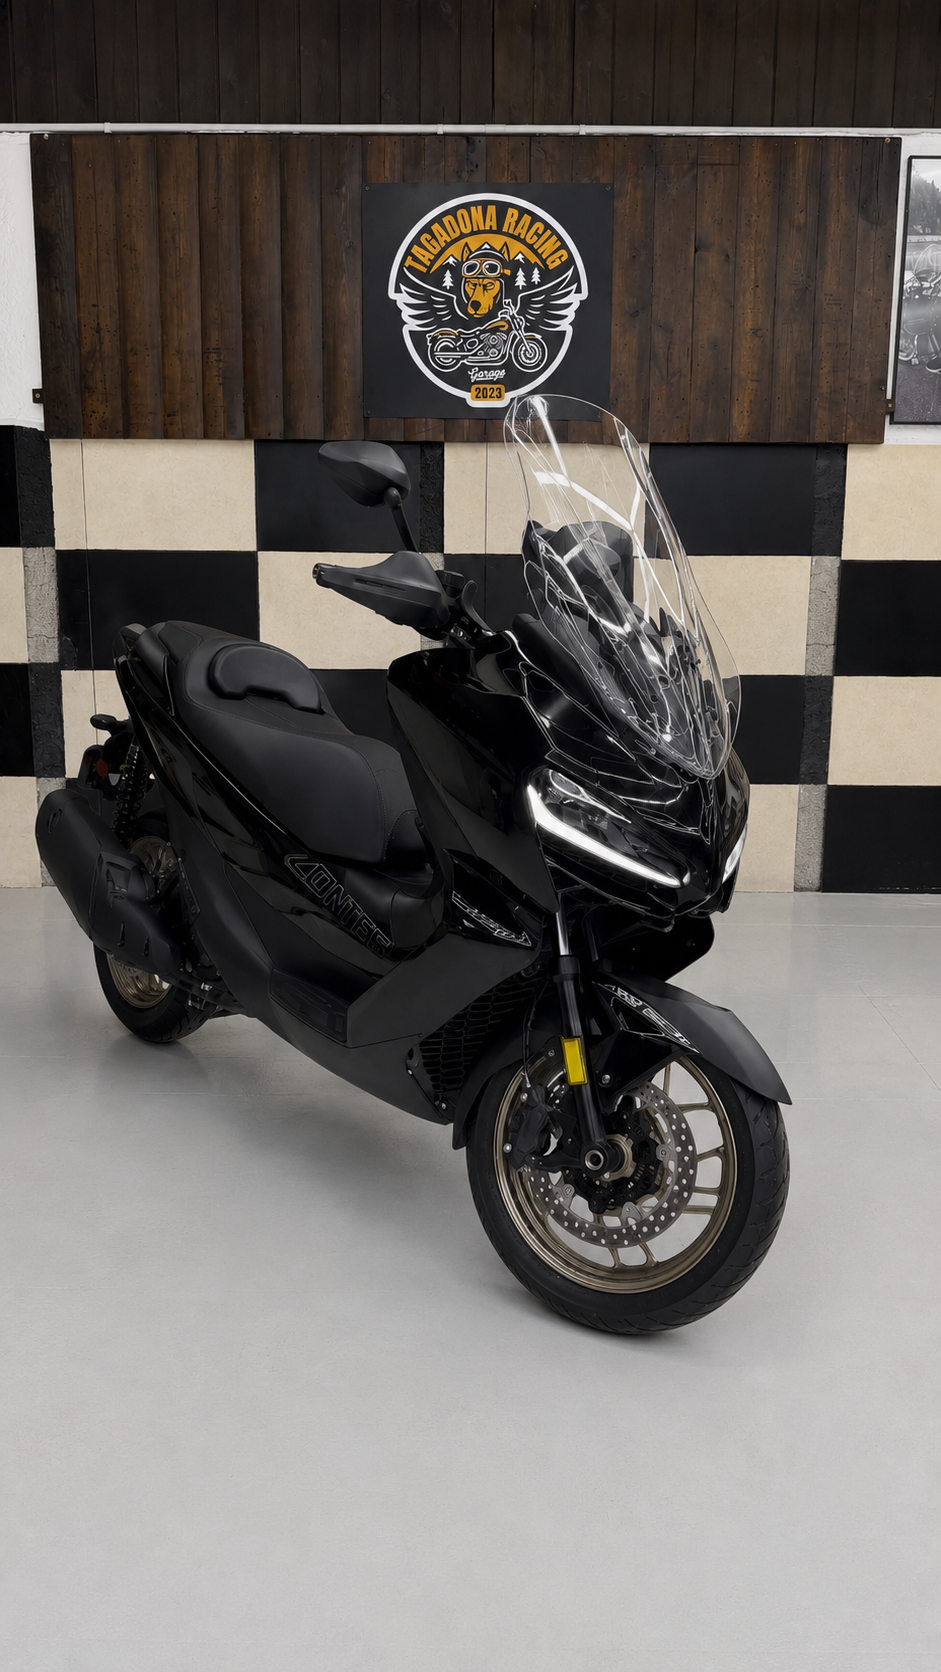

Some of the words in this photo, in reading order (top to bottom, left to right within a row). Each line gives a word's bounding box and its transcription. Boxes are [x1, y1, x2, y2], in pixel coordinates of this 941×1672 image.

[404, 205, 497, 274] TAGADONA
[502, 207, 568, 270] RACING
[475, 387, 502, 399] 2023
